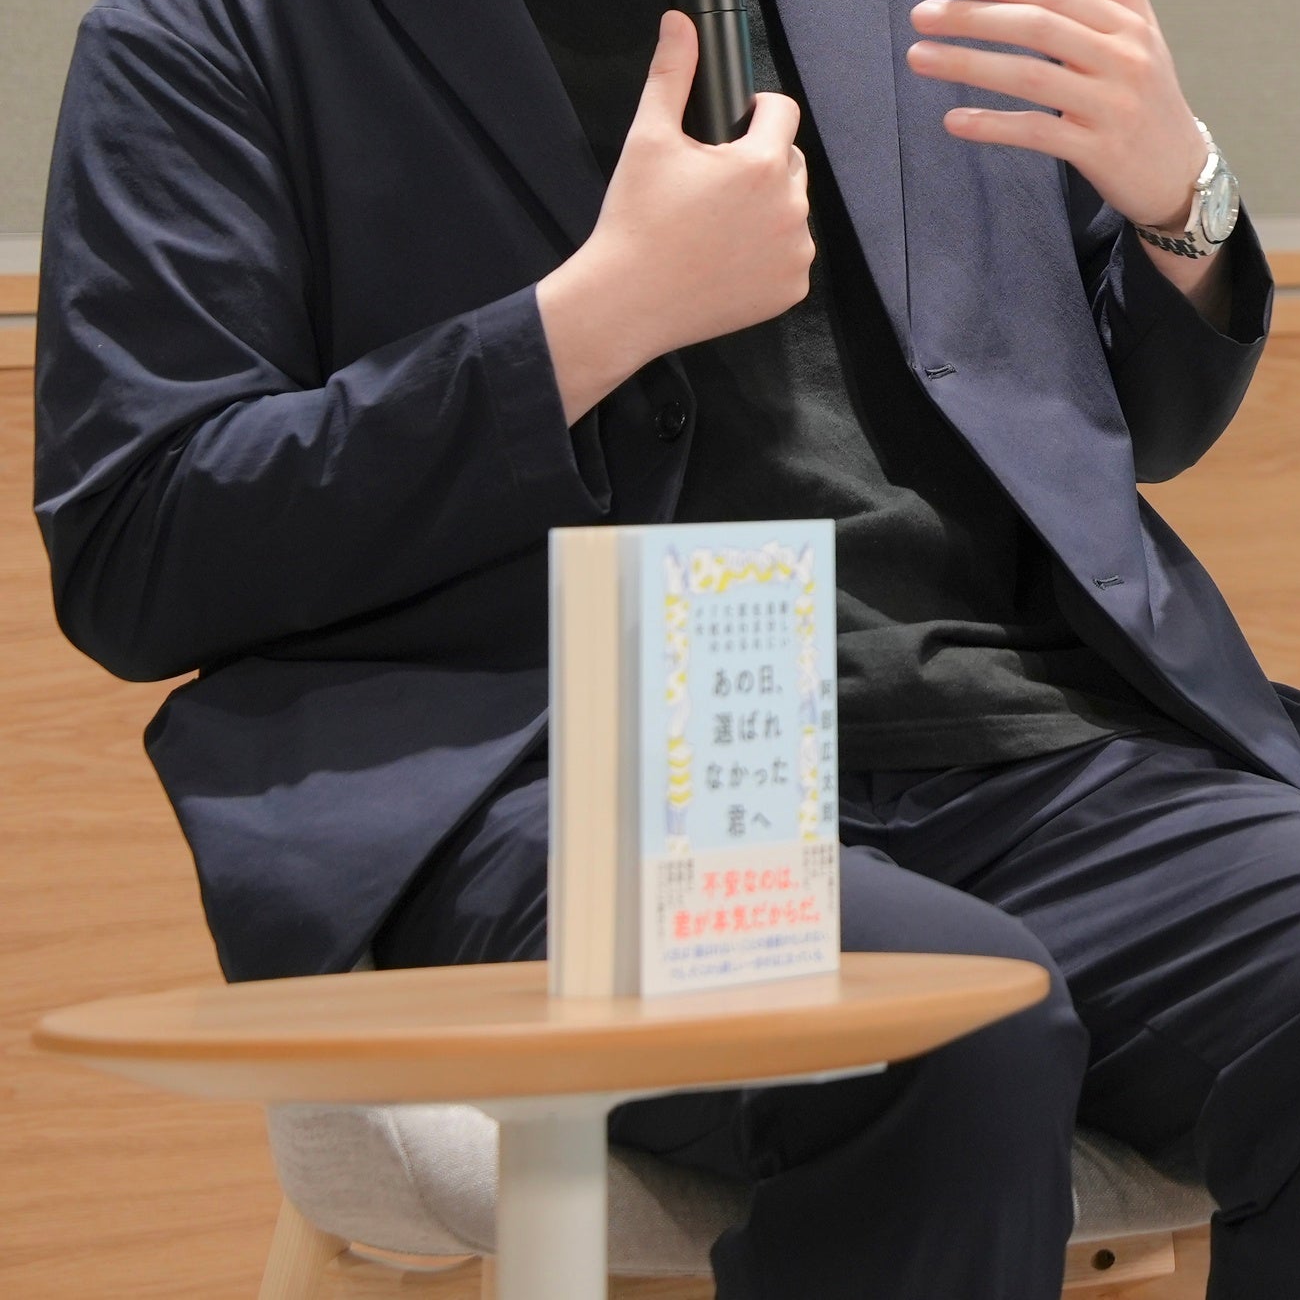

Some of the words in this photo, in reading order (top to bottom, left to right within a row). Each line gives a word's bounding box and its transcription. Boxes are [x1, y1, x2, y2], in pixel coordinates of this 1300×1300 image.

[714, 664, 784, 697] あの日、
[706, 757, 788, 790] なかった
